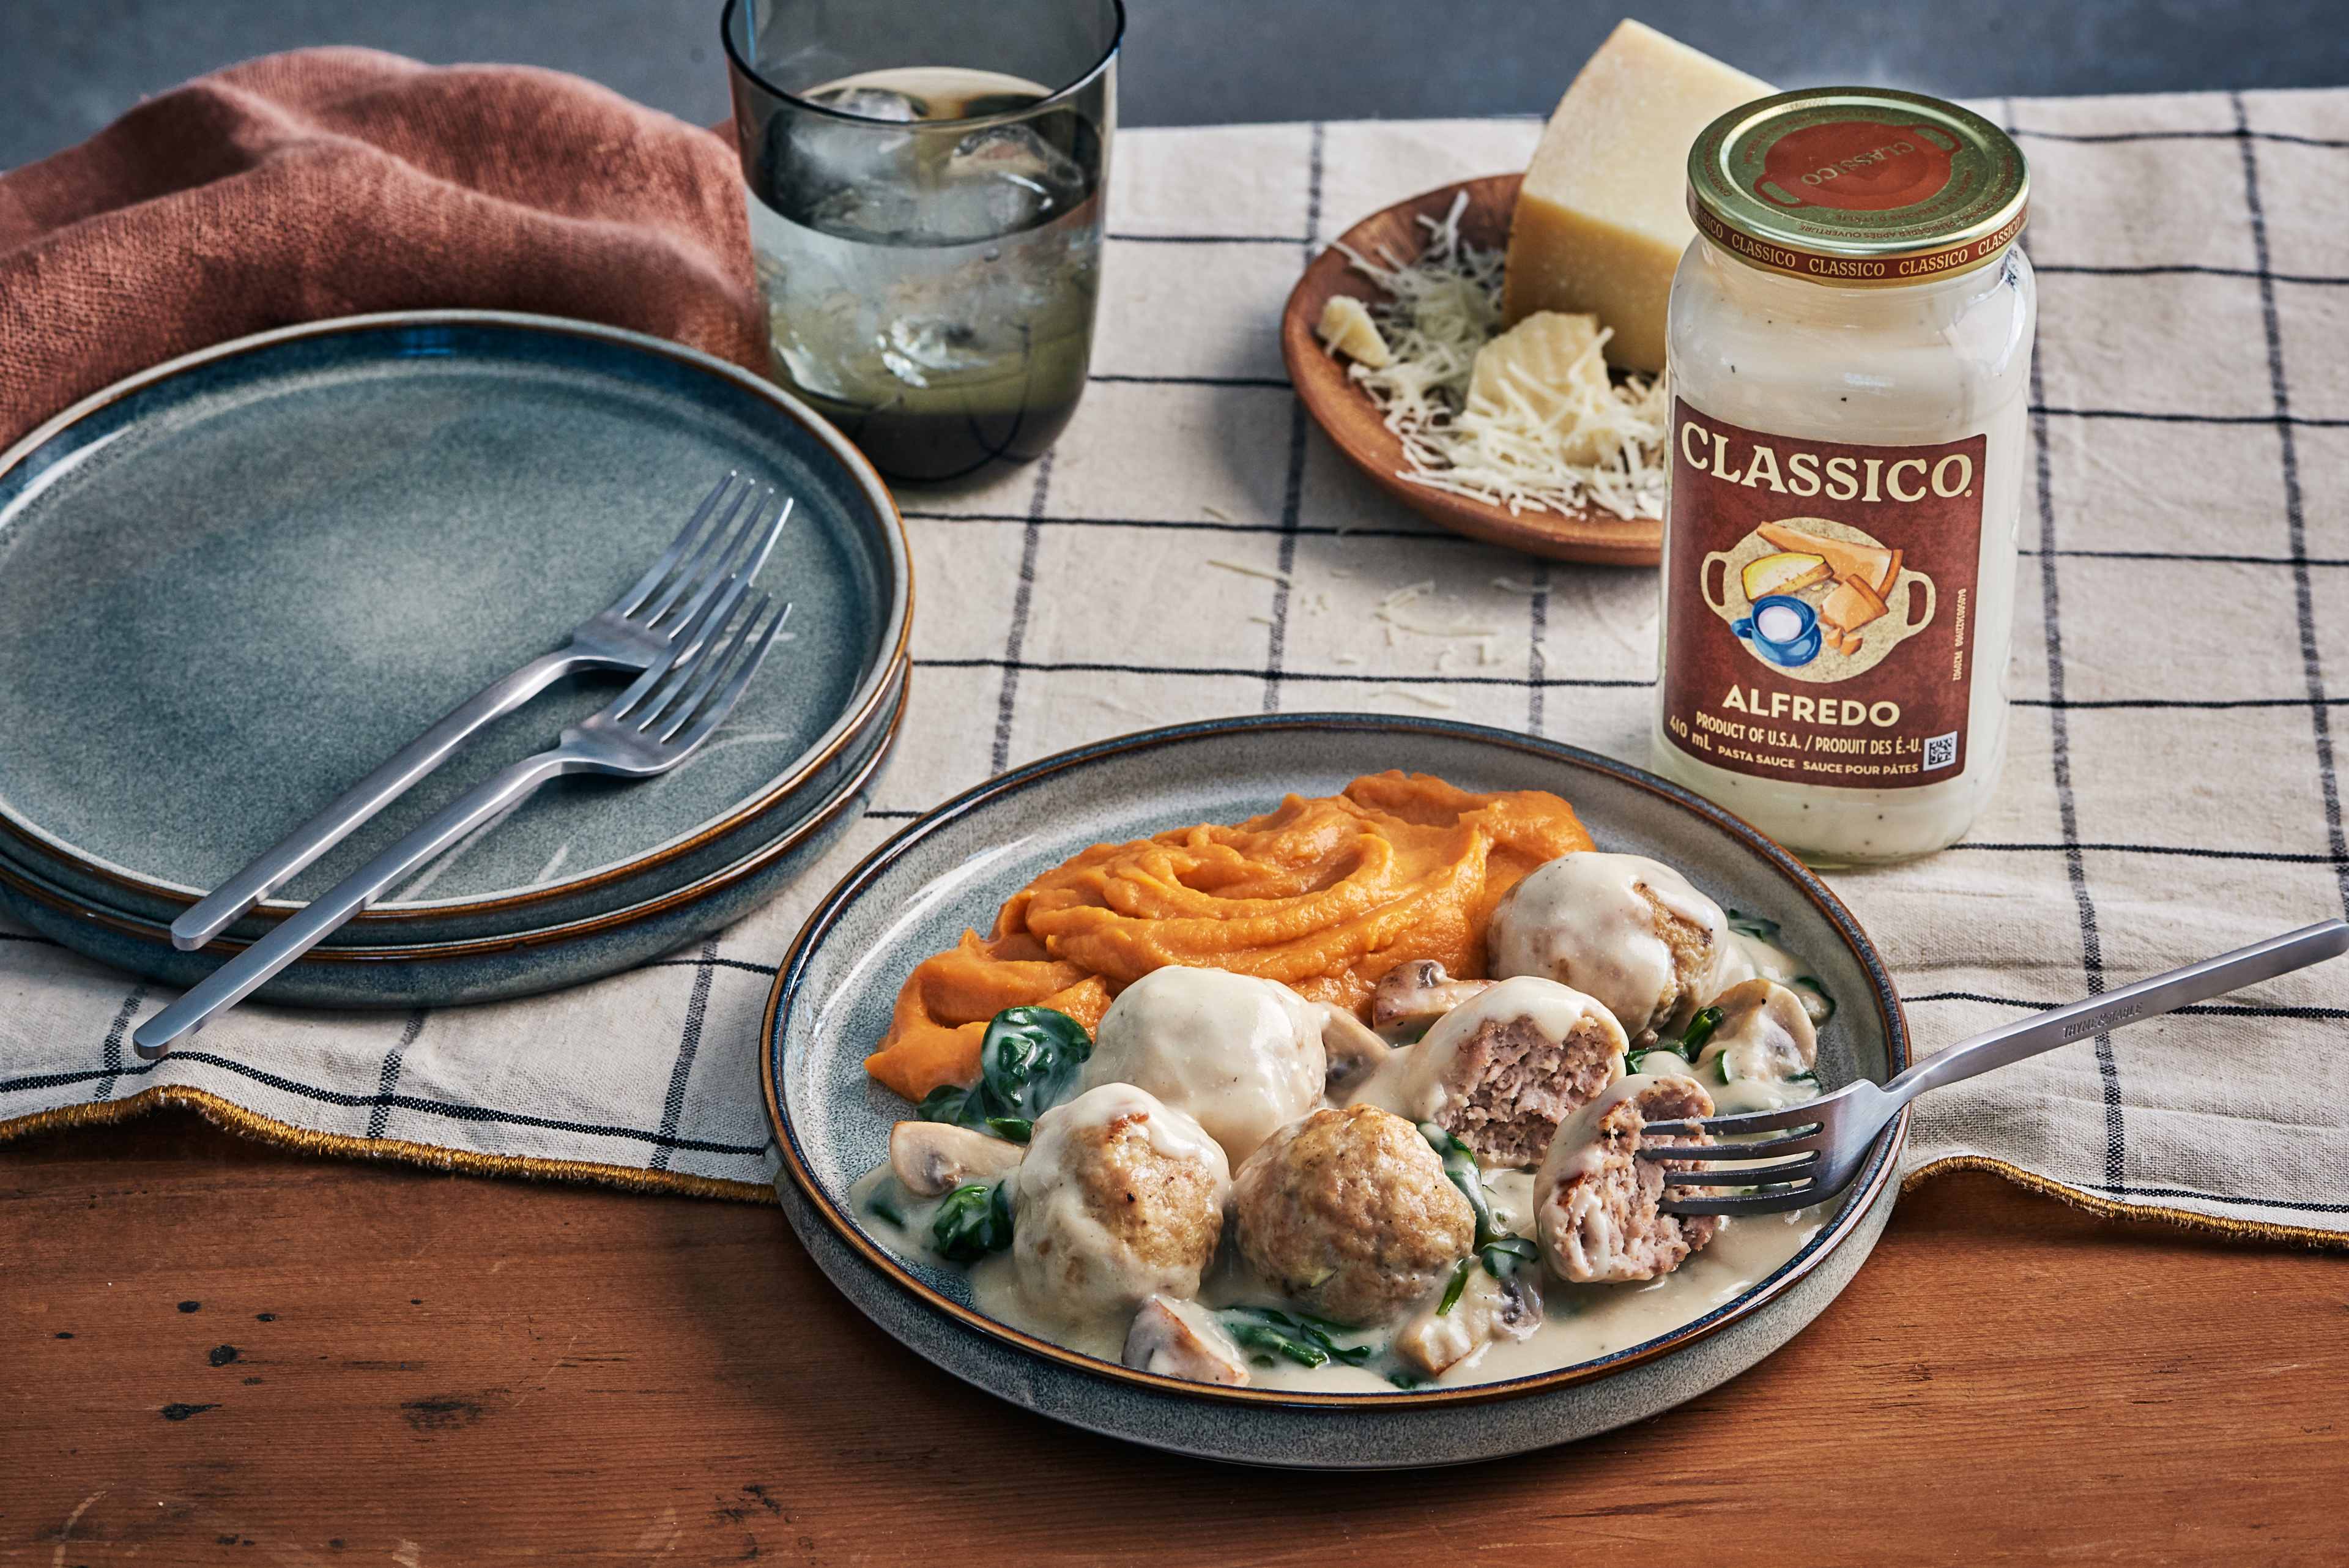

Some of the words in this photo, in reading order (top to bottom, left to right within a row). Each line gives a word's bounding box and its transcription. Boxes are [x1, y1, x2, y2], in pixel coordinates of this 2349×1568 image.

[1801, 142, 1916, 185] CLASSICO
[1732, 234, 1795, 267] CLASSICO
[1809, 258, 1885, 277] CLASSICO
[1899, 249, 1968, 275] CLASSICO
[1978, 216, 2020, 255] CLASSICO
[1799, 224, 1861, 238] OUVERTURE
[1722, 684, 1900, 727] ALFREDO
[1669, 715, 1687, 738] 410
[1692, 732, 1712, 751] mL
[1696, 711, 1745, 740] PRODUCT
[1749, 727, 1764, 743] OF
[1768, 730, 1801, 749] U.S.A.
[1815, 737, 1867, 754] PRODUIT
[1870, 740, 1892, 755] DES
[1896, 736, 1922, 754] É.-U.
[1718, 745, 1753, 762] PASTA
[1756, 754, 1795, 768] SAUCE
[1803, 760, 1842, 774] SAUCE
[1845, 765, 1880, 775] POUR
[1883, 763, 1919, 775] PÂTES
